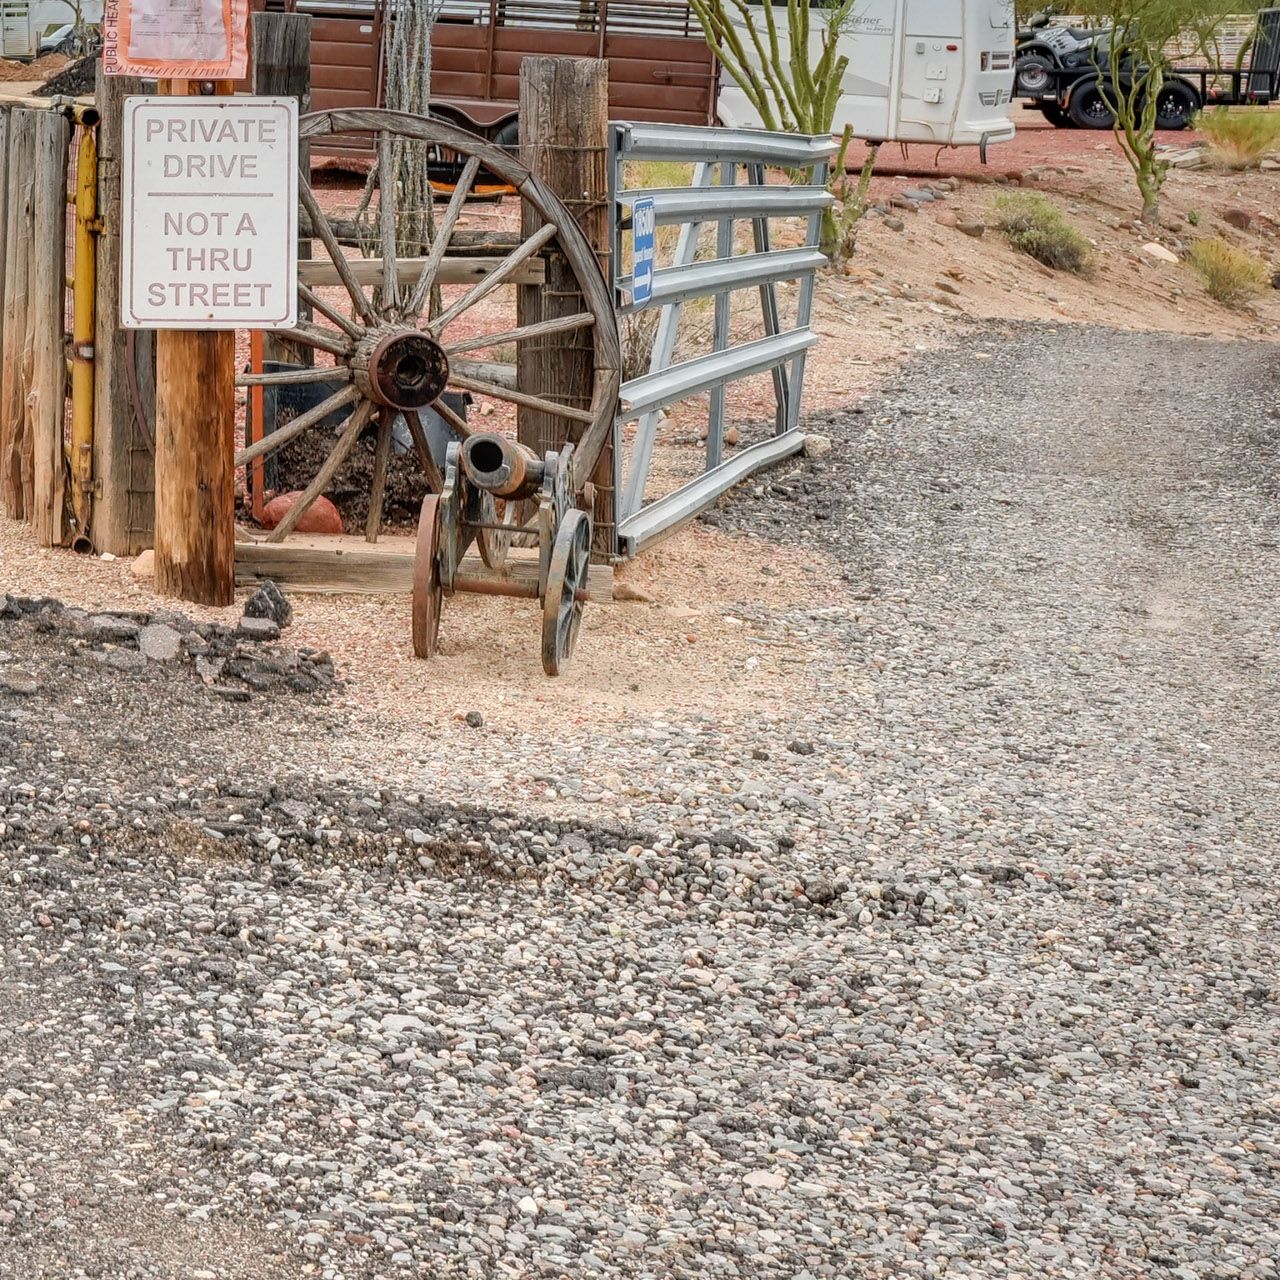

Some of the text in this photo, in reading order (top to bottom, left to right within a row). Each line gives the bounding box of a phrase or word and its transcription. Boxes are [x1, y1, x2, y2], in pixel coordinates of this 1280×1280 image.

[105, 31, 117, 74] PUBLIC
[146, 118, 276, 143] PRIVATE
[164, 154, 258, 179] DRIVE
[164, 211, 257, 236] NOT A
[166, 247, 252, 272] THRU
[147, 282, 272, 308] STREET
